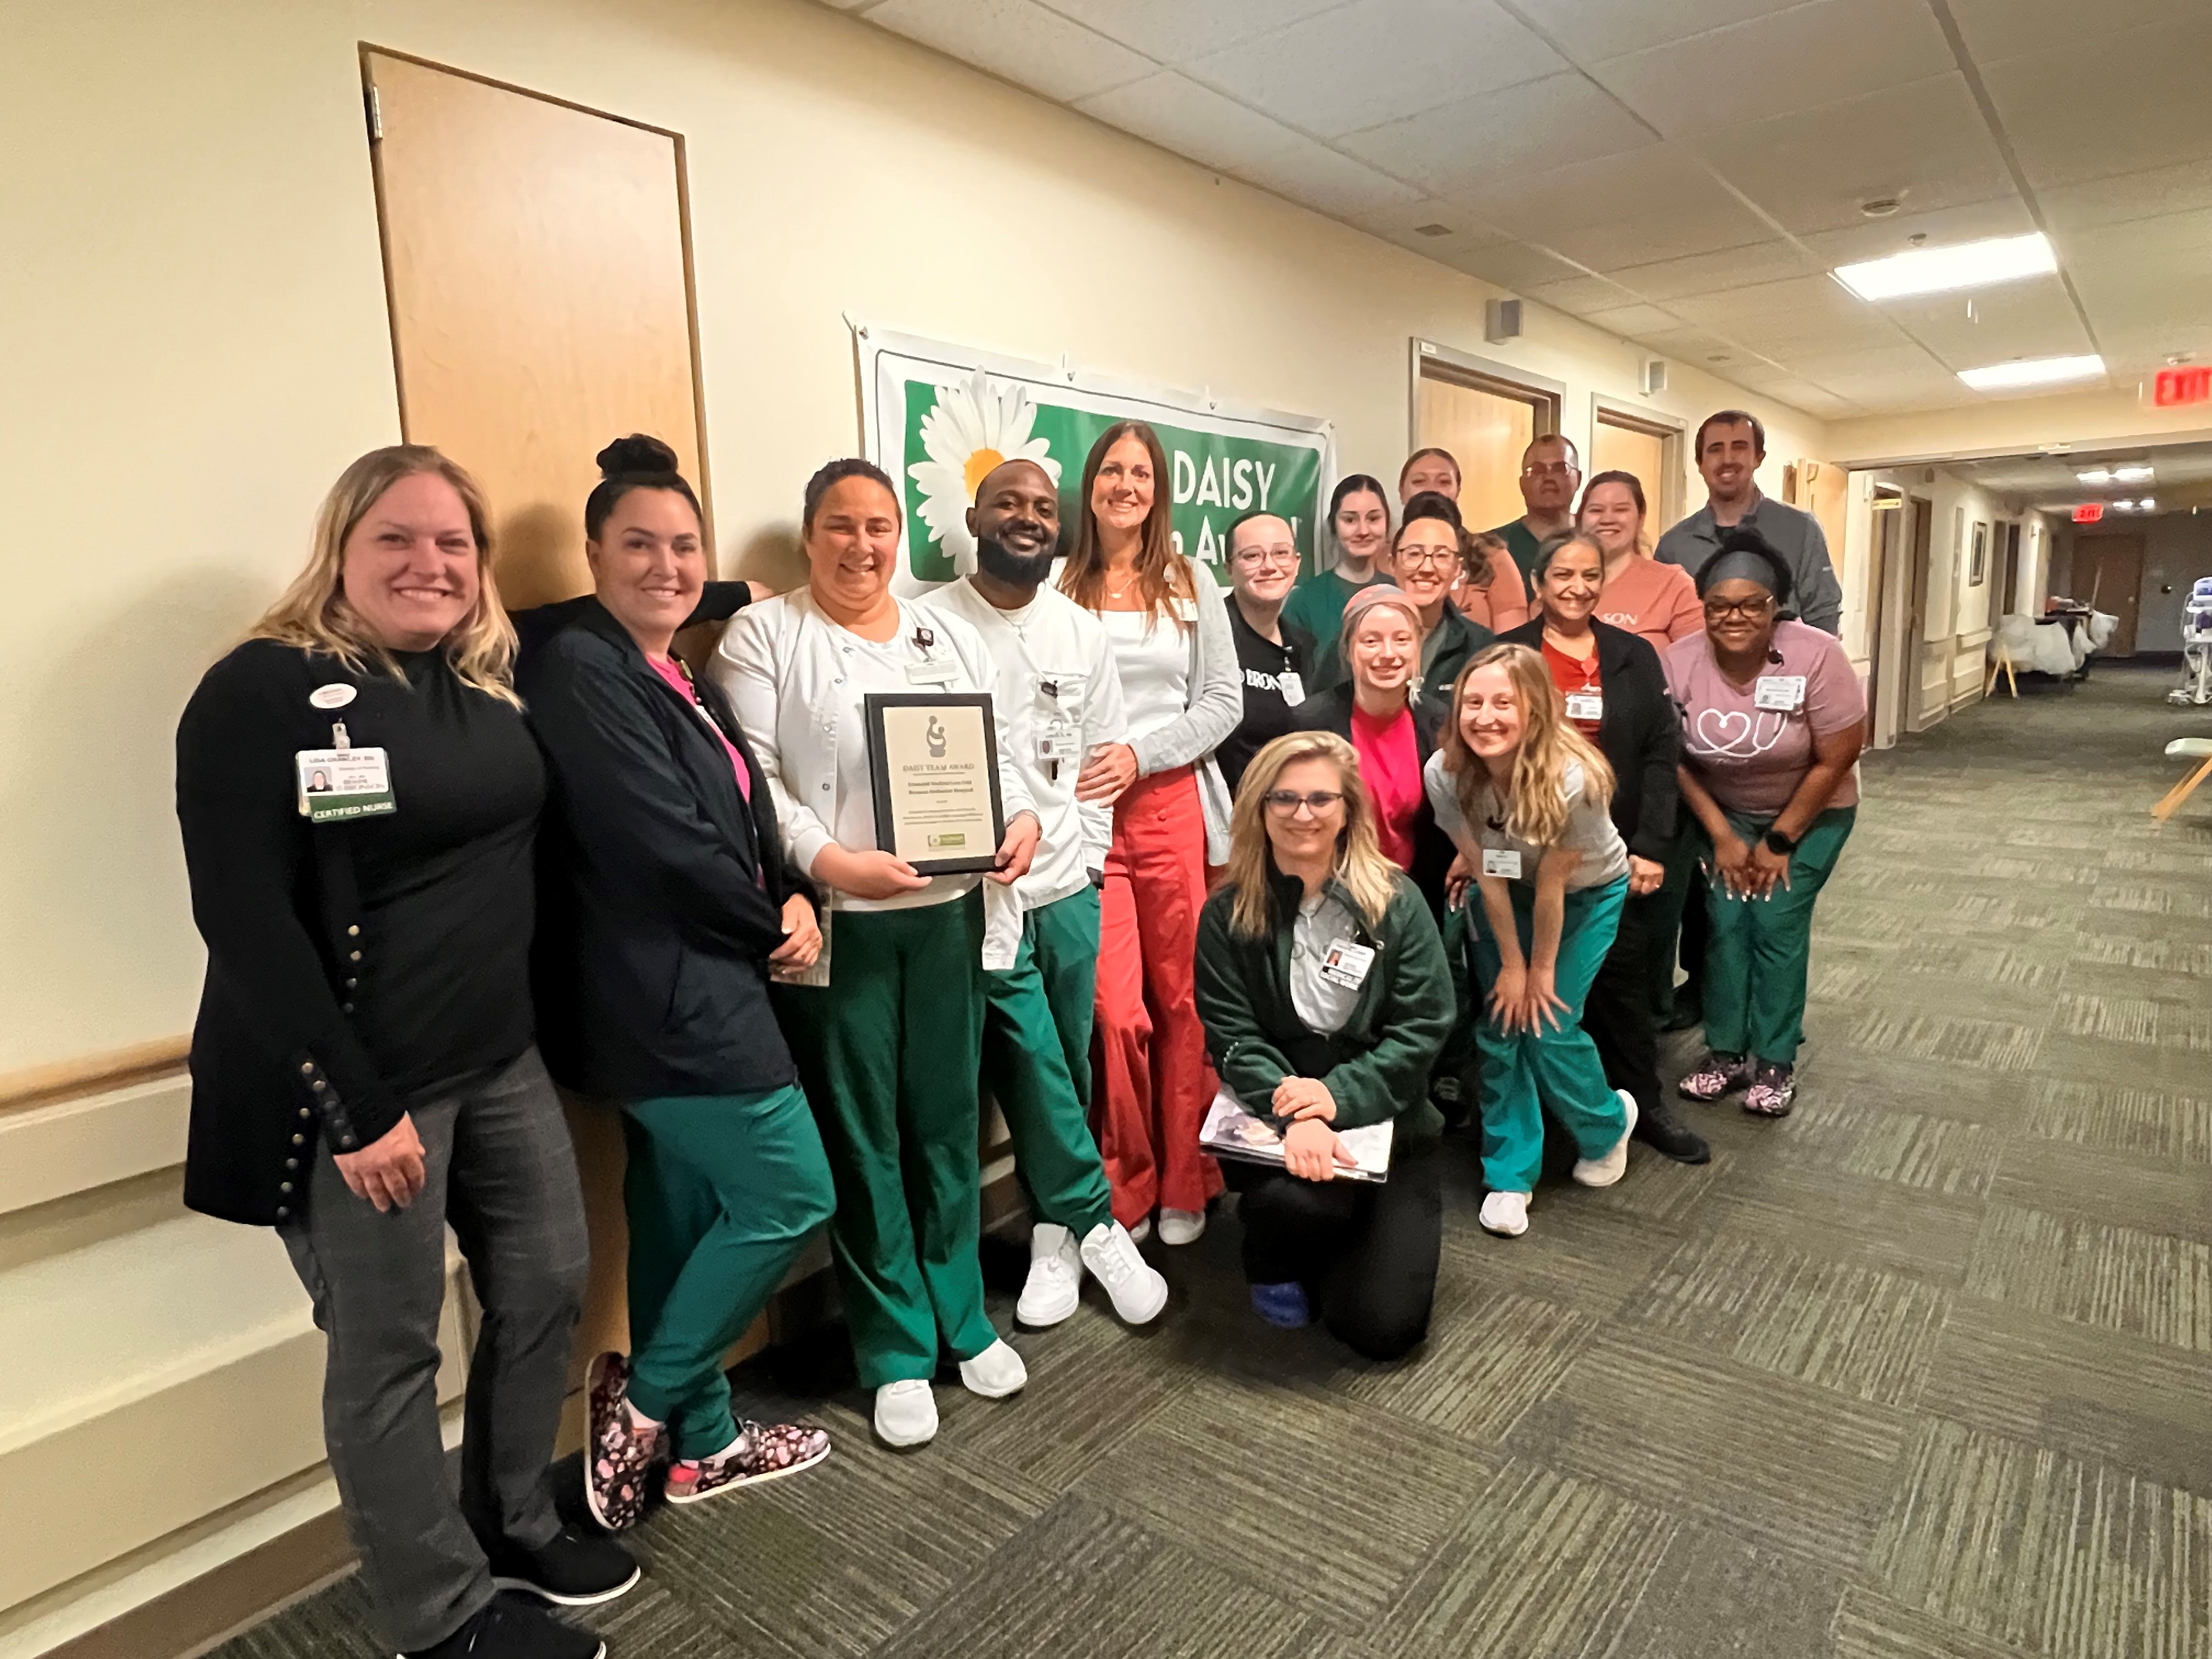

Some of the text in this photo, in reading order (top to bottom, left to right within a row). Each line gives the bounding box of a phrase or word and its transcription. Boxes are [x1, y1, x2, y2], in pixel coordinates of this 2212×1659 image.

[1173, 450, 1276, 511] DAISY
[314, 802, 393, 819] CERTIFIED NURSE
